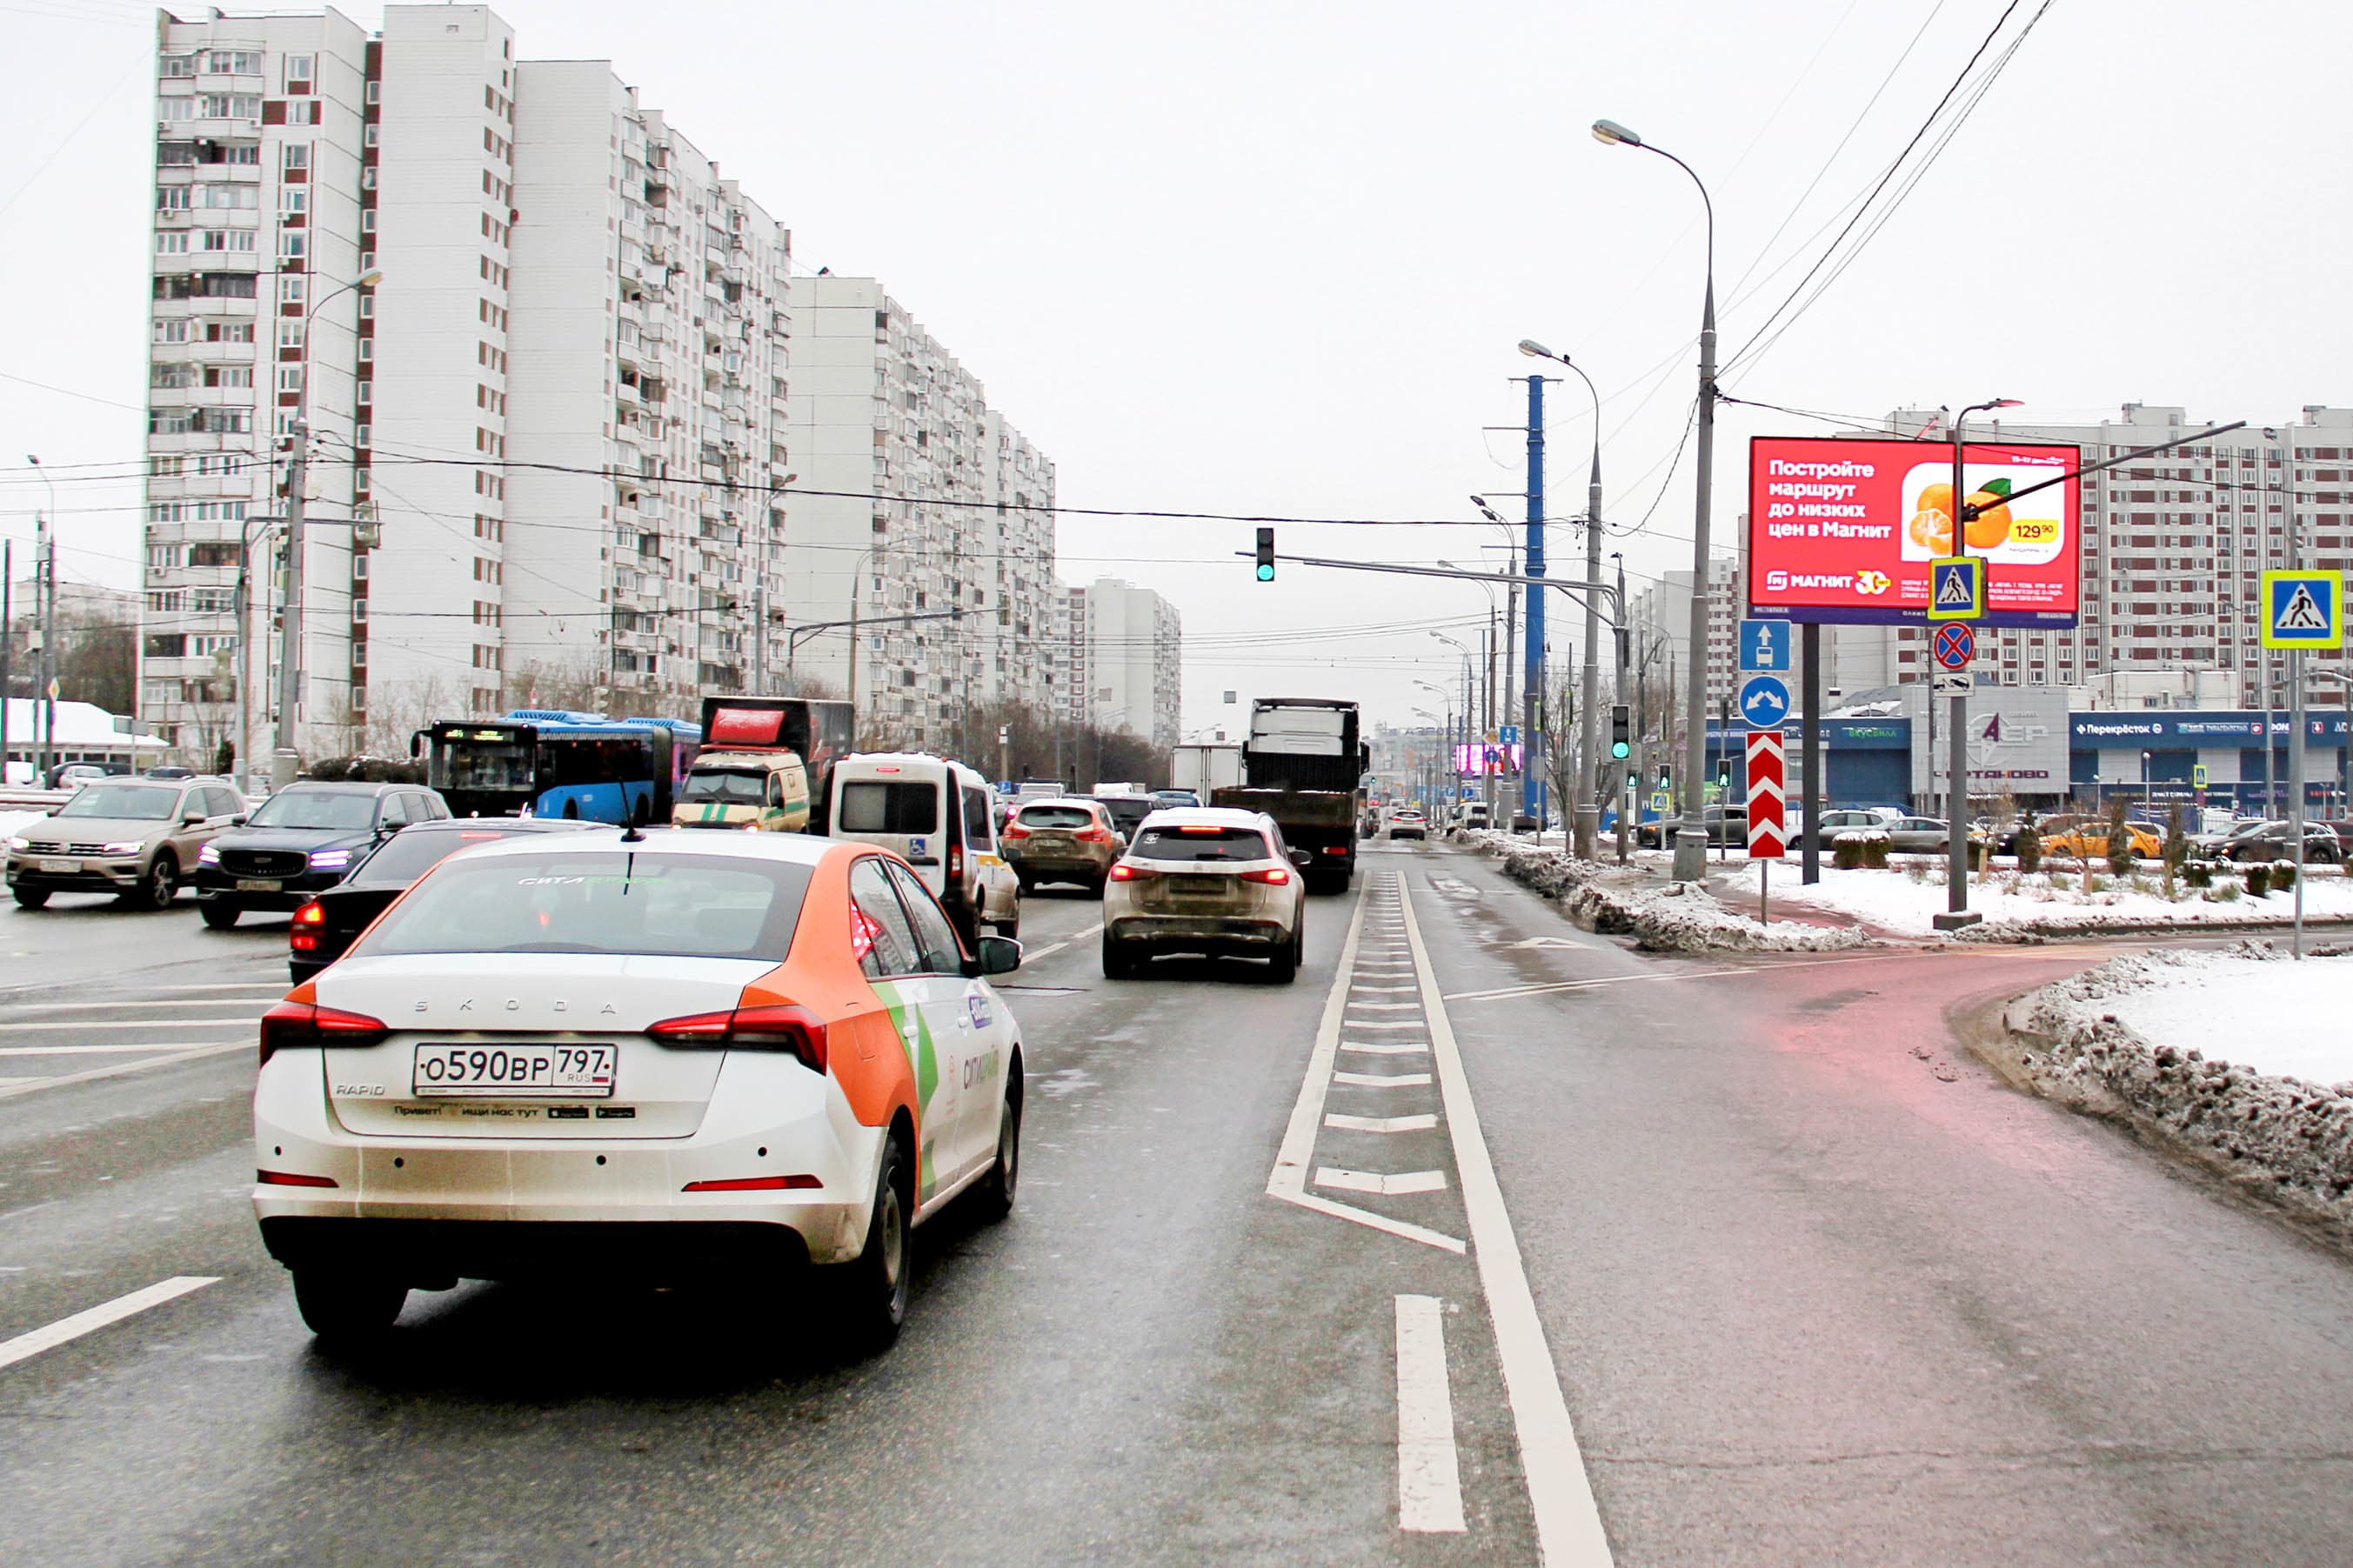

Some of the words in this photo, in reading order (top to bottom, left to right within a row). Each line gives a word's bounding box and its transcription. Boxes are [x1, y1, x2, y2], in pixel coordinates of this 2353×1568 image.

[1769, 459, 1875, 479] Постройте
[1768, 483, 1856, 500] маршрут
[1768, 503, 1795, 517] до
[1798, 504, 1866, 517] низких
[1768, 523, 1805, 538] цен
[1808, 524, 1819, 537] в
[1822, 521, 1892, 538] Магнит
[2015, 525, 2041, 537] 129
[1790, 575, 1854, 588] МАГНИТ
[2087, 724, 2150, 736] Перекрёсток
[415, 998, 616, 1014] SKODA
[426, 1051, 549, 1081] О590ВР
[558, 1050, 605, 1073] 797
[567, 1073, 591, 1083] RUS
[336, 1085, 385, 1096] RAPID
[394, 1105, 442, 1116] Привет!
[462, 1107, 489, 1117] ищи
[491, 1108, 514, 1117] нас
[516, 1108, 538, 1118] тут
